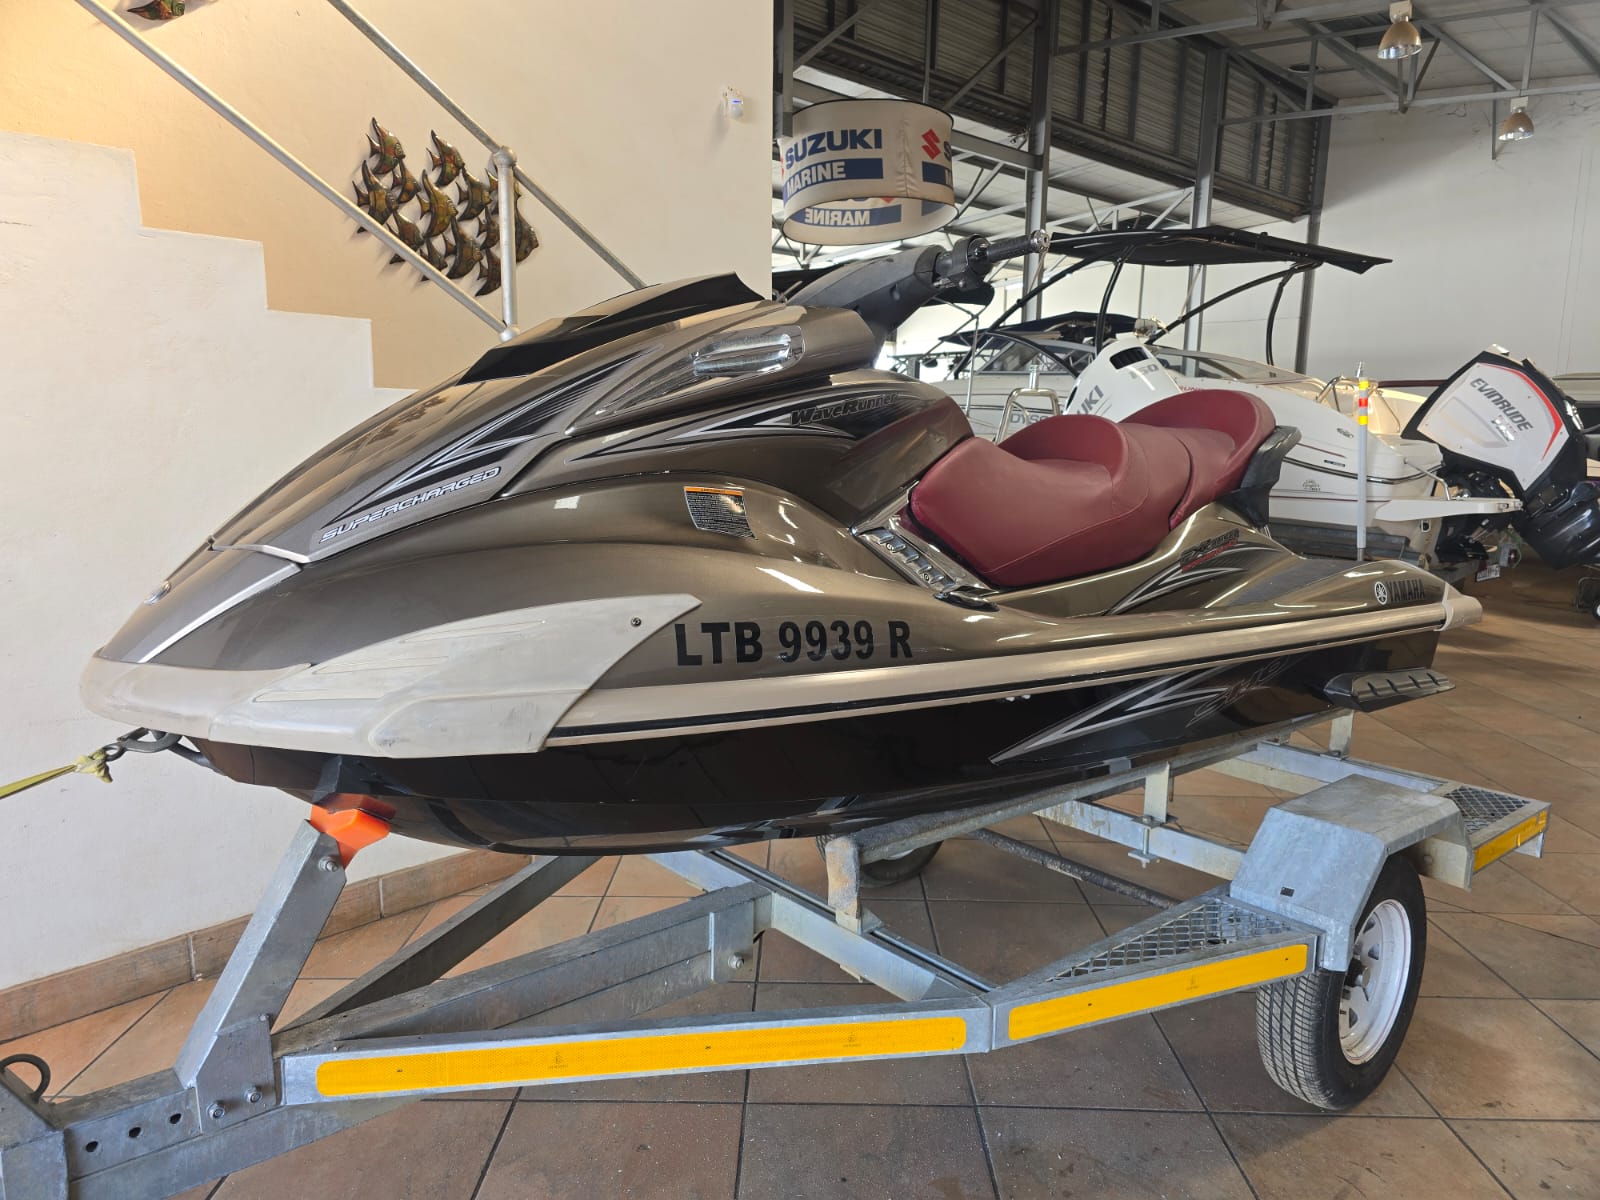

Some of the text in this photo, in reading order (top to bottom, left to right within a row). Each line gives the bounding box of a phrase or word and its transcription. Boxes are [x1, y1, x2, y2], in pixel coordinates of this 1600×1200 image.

[785, 128, 882, 170] SUZUKI
[786, 161, 846, 197] MARINE
[790, 393, 897, 426] WaveRunner
[1470, 378, 1534, 431] EVINRUDE
[319, 467, 502, 544] SUPERCHARGED
[1385, 579, 1425, 602] YAMAHA
[674, 620, 913, 666] LTB 9939 R
